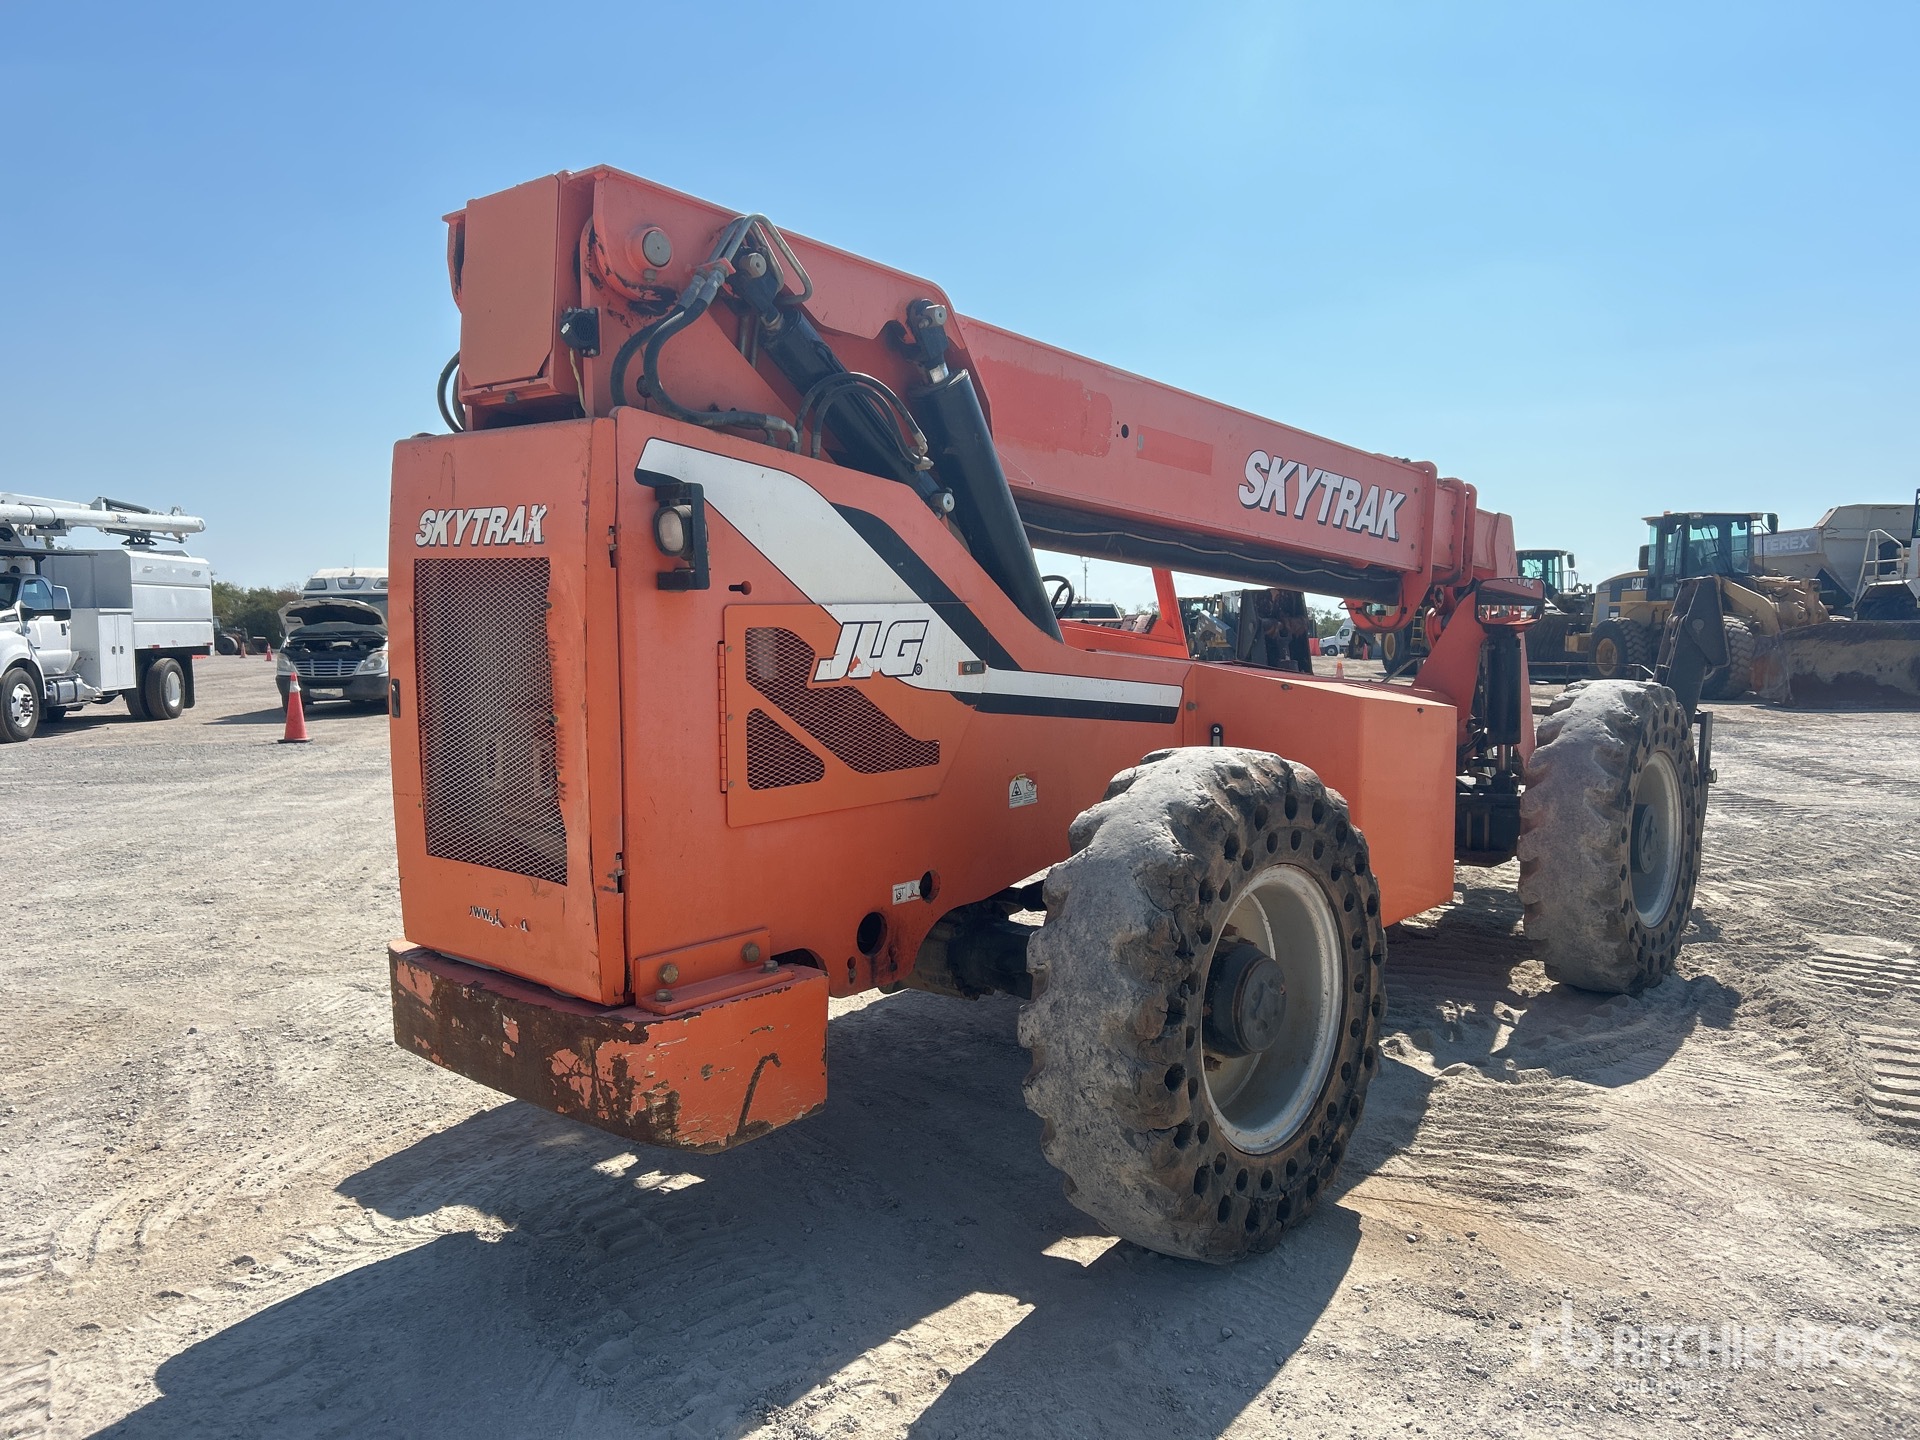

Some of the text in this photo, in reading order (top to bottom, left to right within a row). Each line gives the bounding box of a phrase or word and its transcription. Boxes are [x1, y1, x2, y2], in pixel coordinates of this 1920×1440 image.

[1238, 449, 1406, 542] SKYTRAK
[415, 504, 547, 547] SKYTRAK
[1764, 534, 1810, 550] TEREX
[1631, 577, 1645, 590] CAT
